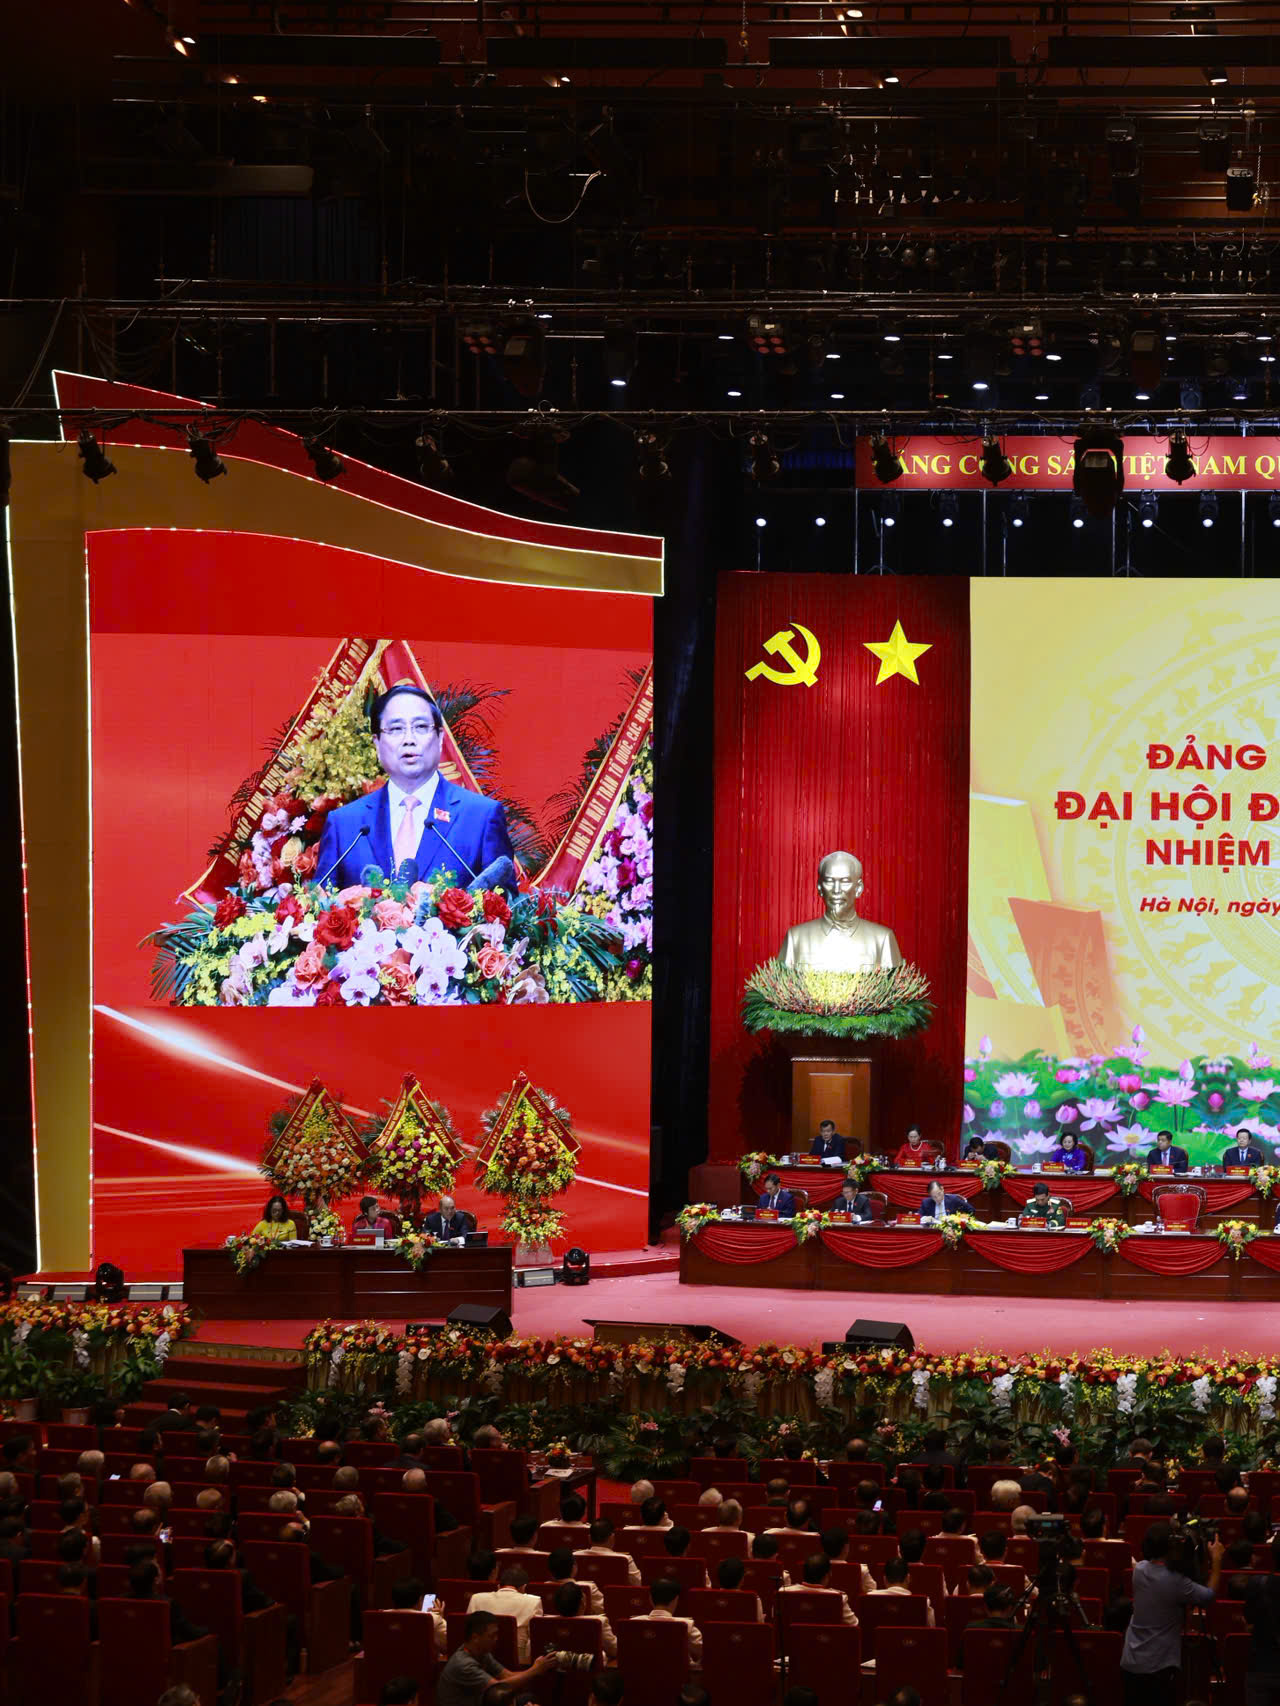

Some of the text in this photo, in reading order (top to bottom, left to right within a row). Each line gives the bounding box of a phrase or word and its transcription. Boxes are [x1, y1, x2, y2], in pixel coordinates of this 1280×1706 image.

[873, 449, 952, 475] ẢNG
[958, 454, 1039, 475] CNG
[1146, 735, 1267, 771] ĐẢNG
[1055, 792, 1133, 829] ĐẠI
[1151, 784, 1231, 830] HỘI
[1146, 832, 1270, 873] NHIỆM
[1139, 896, 1172, 913] Hà
[1177, 897, 1219, 918] Nội,
